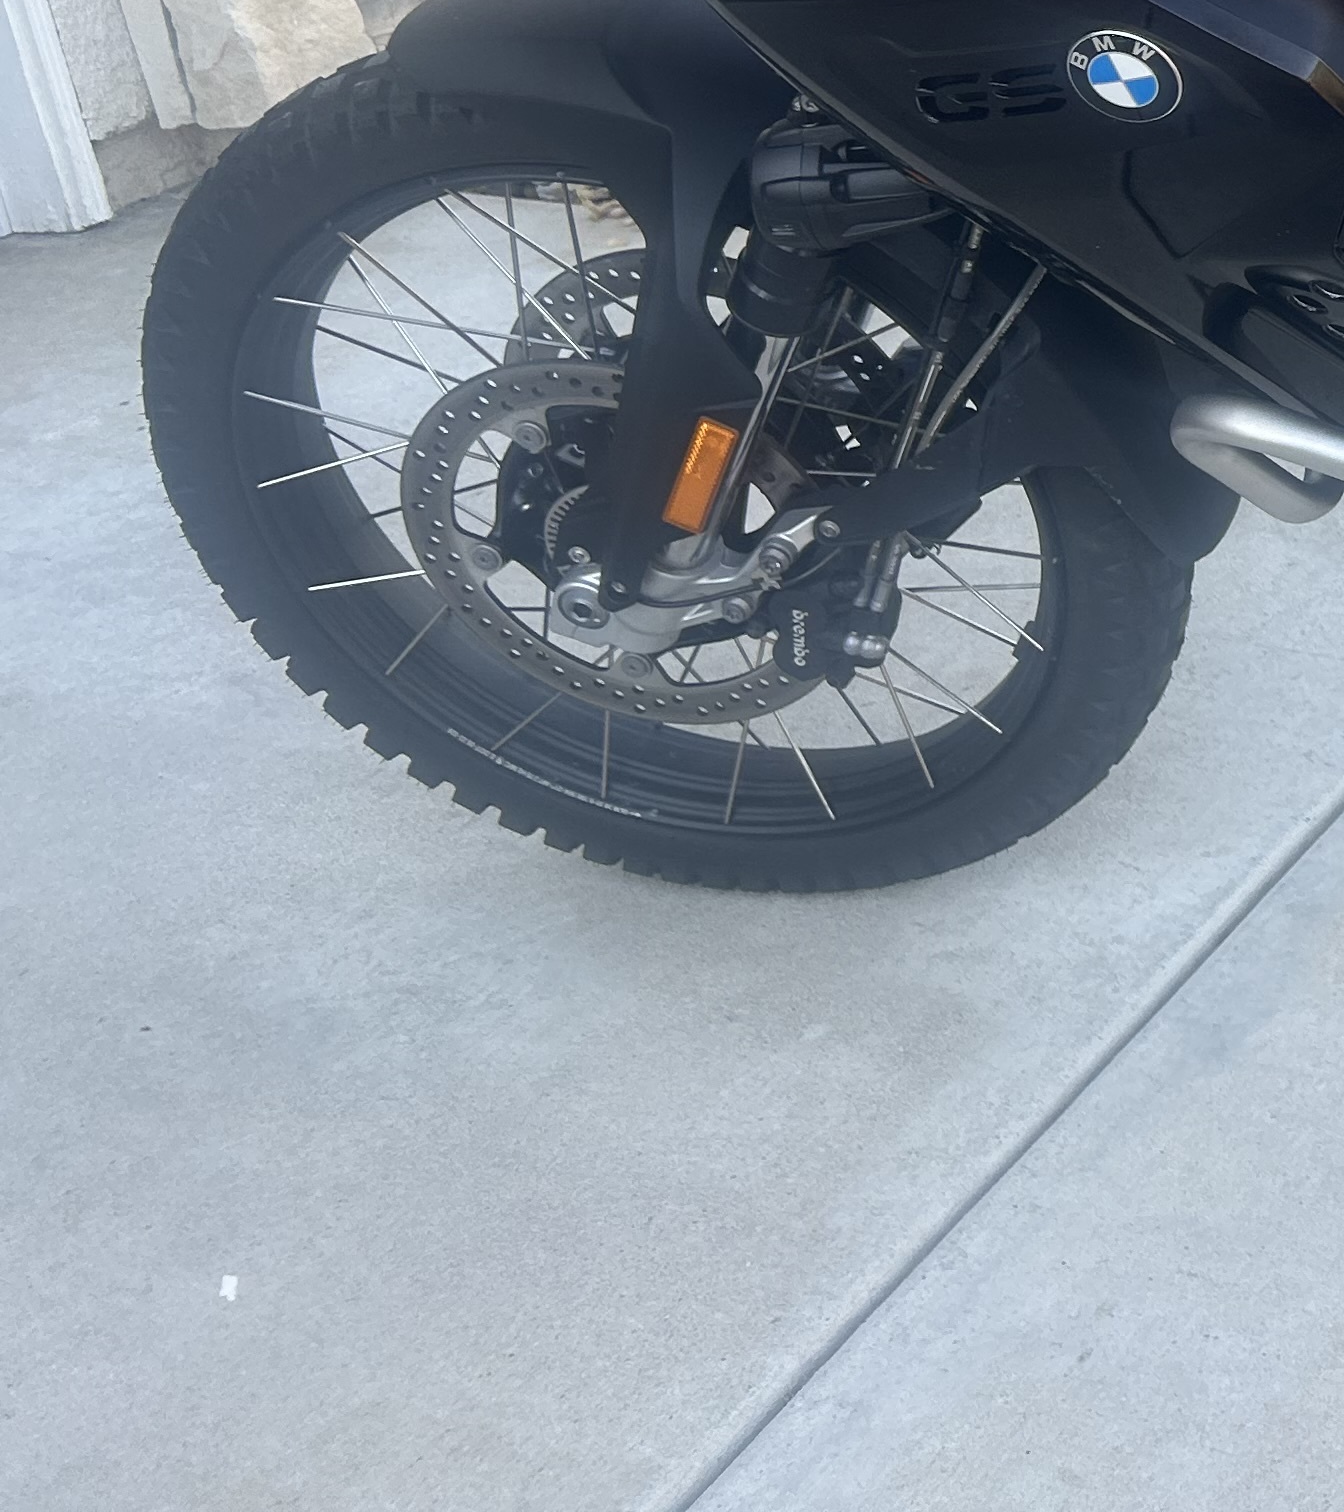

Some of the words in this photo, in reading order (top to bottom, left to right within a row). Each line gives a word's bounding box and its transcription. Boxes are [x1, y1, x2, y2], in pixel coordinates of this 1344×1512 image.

[1069, 35, 1156, 71] BMW
[915, 64, 1067, 123] GS
[791, 609, 810, 667] brembo
